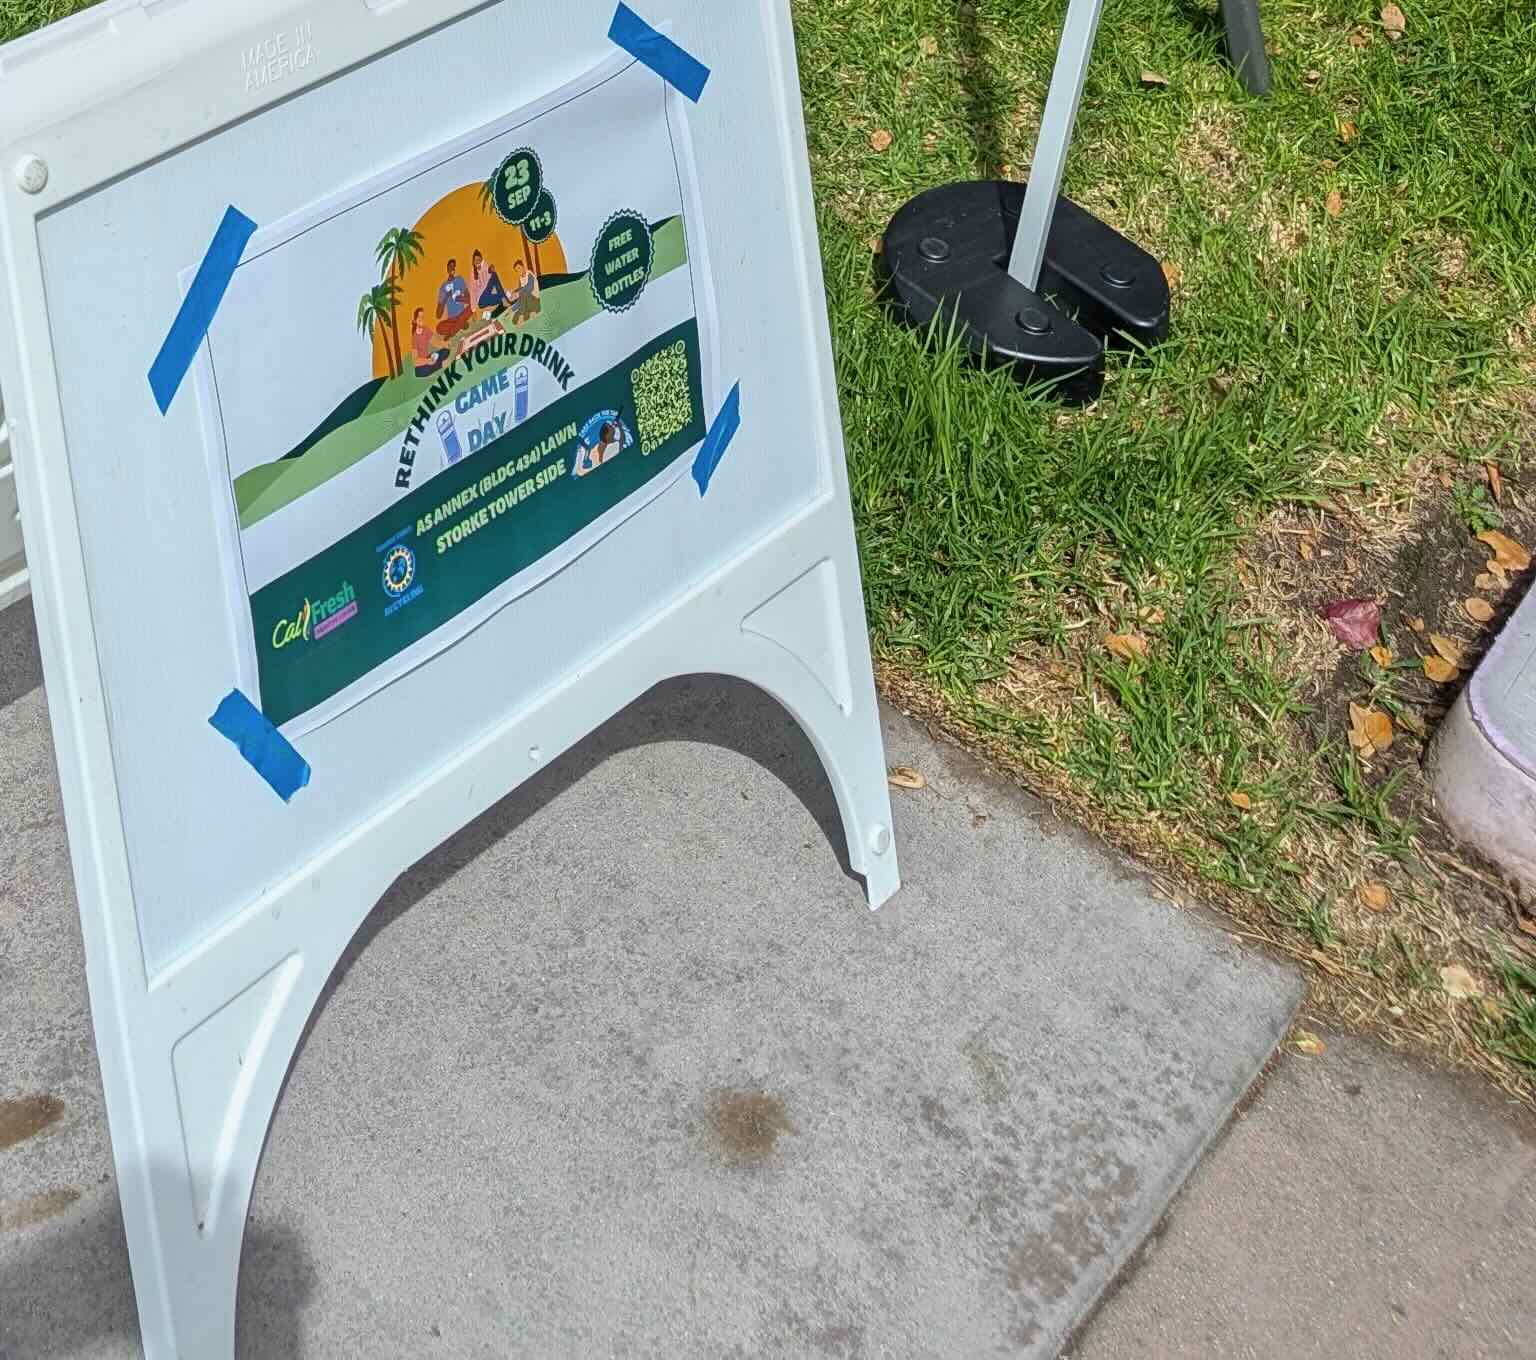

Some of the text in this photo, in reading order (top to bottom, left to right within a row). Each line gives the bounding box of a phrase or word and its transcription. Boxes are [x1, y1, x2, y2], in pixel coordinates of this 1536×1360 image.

[239, 20, 313, 73] MADE IN
[245, 47, 320, 92] AMERICA
[504, 159, 530, 189] 23
[507, 186, 532, 209] SEP
[529, 211, 552, 231] 11-3
[608, 229, 633, 252] FREE
[604, 248, 639, 276] WATER
[604, 266, 645, 300] BOTTLES
[395, 333, 575, 489] RETHINK YOUR DRINK
[454, 368, 511, 415] GAME
[467, 411, 507, 452] DAY
[416, 514, 433, 536] AS
[434, 483, 479, 526] ANNEX
[479, 460, 516, 497] (BLDG
[515, 445, 541, 472] 434)
[540, 422, 578, 457] LAWN
[436, 508, 490, 554] STORKE
[488, 482, 537, 520] TOWER
[536, 459, 567, 490] SIDE
